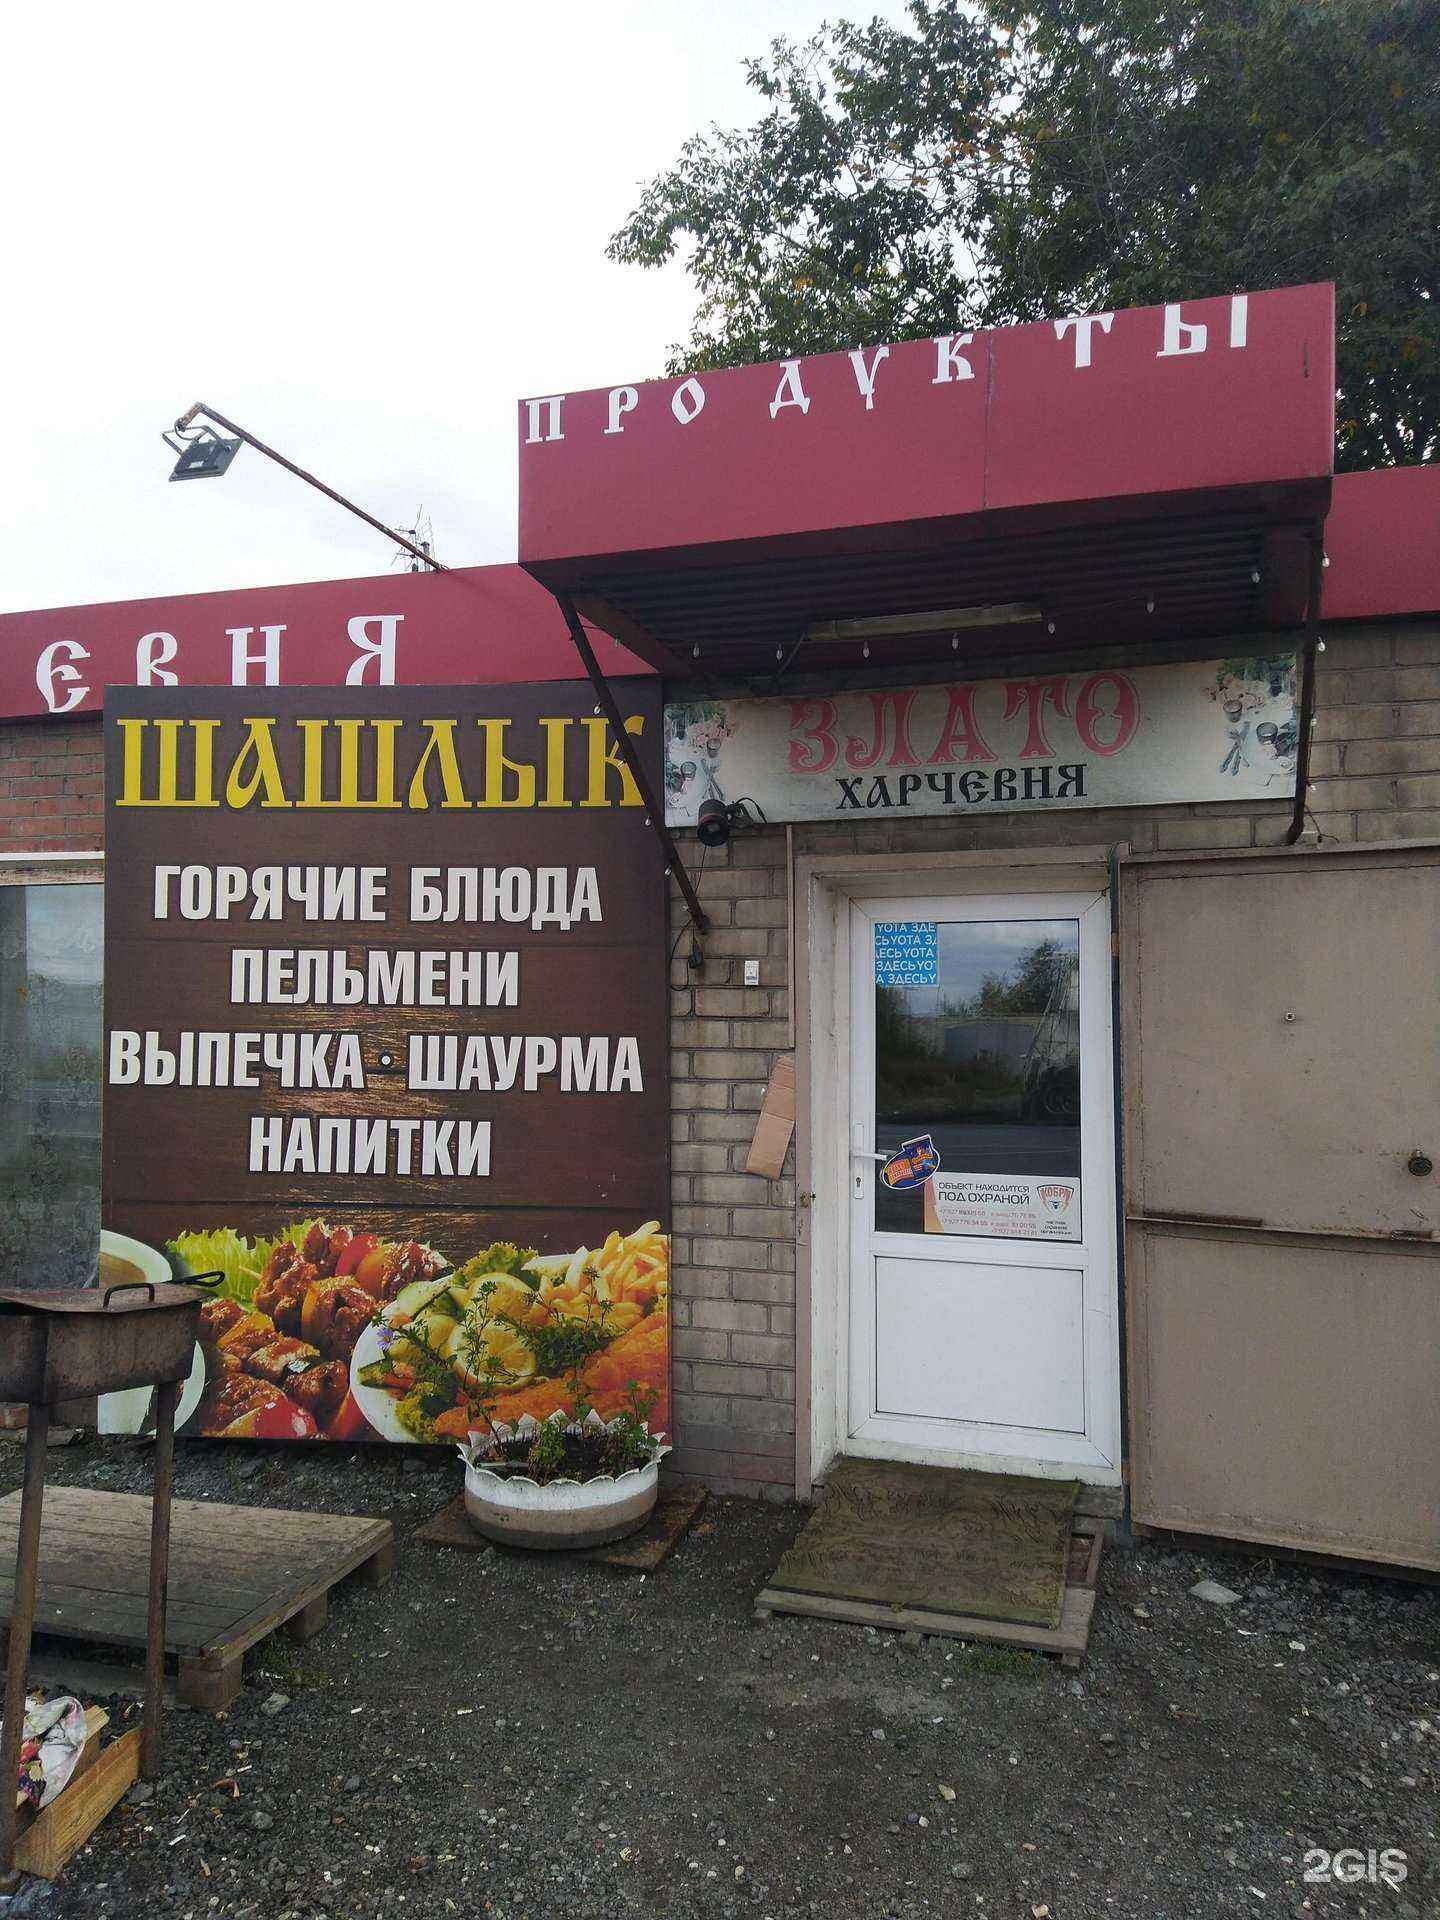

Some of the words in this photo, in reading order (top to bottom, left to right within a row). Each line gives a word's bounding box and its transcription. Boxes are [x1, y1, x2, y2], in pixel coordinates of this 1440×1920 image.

[524, 295, 1248, 445] ПРОДУКТЫ
[786, 671, 1141, 774] ЗЛАТО
[115, 715, 645, 809] ШАШЛЫК
[835, 763, 1088, 811] ХАРЧЕВНЯ
[154, 865, 387, 922] ГОРЯЧИЕ
[410, 867, 603, 930] БЛЮДА
[231, 949, 519, 1006] ПЕЛЬМЕНИ
[108, 1030, 366, 1089] ВЫПЕЧКА
[408, 1035, 644, 1092] ШАУРМА
[249, 1116, 492, 1177] НАПИТКИ
[938, 1182, 973, 1191] ОБЪЕКТ
[975, 1184, 1030, 1193] НАХОДИТСЯ
[938, 1191, 965, 1202] ПОД
[968, 1192, 1030, 1205] ОХРАНОЙ
